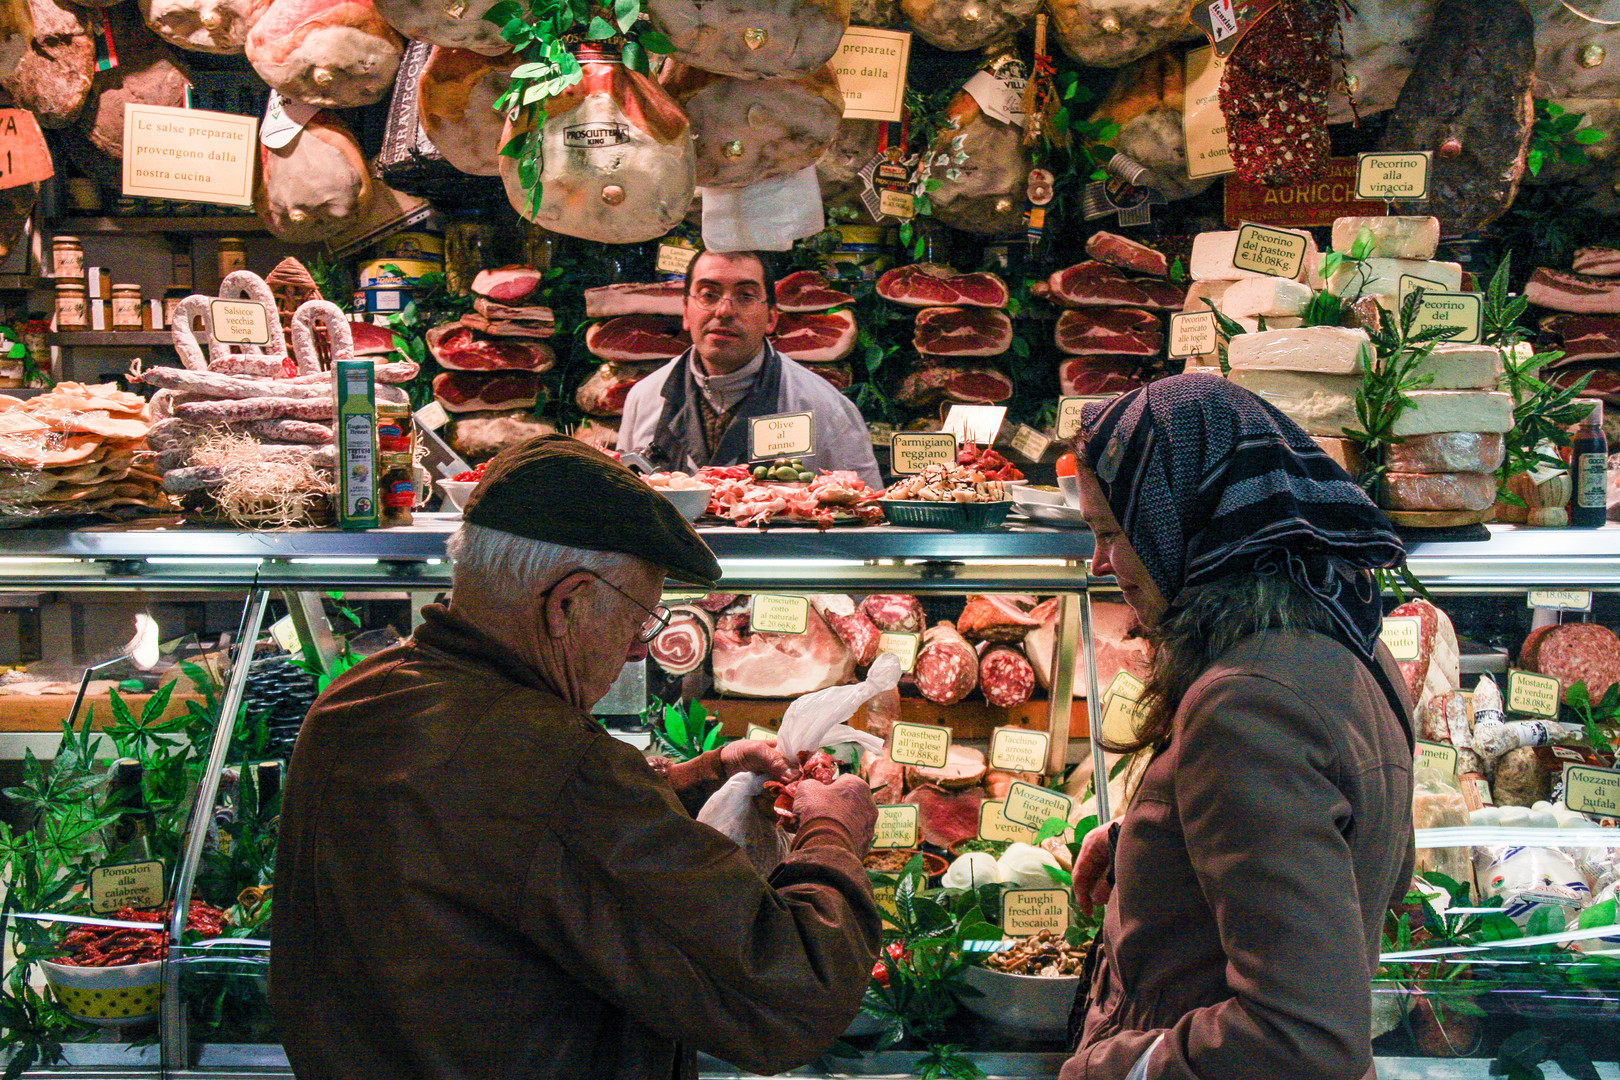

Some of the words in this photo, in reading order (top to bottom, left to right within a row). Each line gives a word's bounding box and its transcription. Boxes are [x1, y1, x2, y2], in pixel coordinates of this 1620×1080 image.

[1212, 3, 1235, 31] Renzini
[842, 44, 896, 56] preparate
[860, 67, 888, 78] dalla
[138, 119, 152, 130] Le
[156, 122, 184, 133] salse
[188, 127, 244, 140] preparate
[136, 145, 204, 159] provengono
[208, 150, 236, 162] dalla
[1370, 159, 1418, 169] Pecorino
[136, 169, 170, 179] nostra
[174, 171, 211, 183] cucina
[1382, 170, 1402, 180] alla
[1370, 183, 1414, 193] vinaccia
[1251, 231, 1293, 247] Pecorino
[1243, 241, 1258, 251] del
[1260, 245, 1296, 260] pastore
[1241, 252, 1292, 270] €.18.08Kg.
[224, 306, 254, 316] Salsicce
[1424, 301, 1465, 310] ecorino
[1181, 315, 1208, 324] Pecorino
[1431, 311, 1449, 320] del
[225, 317, 255, 326] vecchia
[230, 325, 252, 335] Siena
[1178, 335, 1190, 343] alle
[1190, 333, 1208, 343] foglie
[768, 421, 794, 431] Olive
[776, 431, 786, 439] al
[767, 441, 795, 451] ranno
[894, 438, 953, 449] Parmigiano
[901, 450, 948, 460] reggiano
[763, 596, 800, 605] Prosciutto
[769, 613, 799, 621] naturale
[1402, 627, 1412, 635] di
[1517, 676, 1553, 690] Mostarda
[1514, 687, 1523, 695] di
[1525, 689, 1554, 700] verdura
[900, 728, 942, 741] Roastbeef
[898, 739, 941, 752] all'inglese
[1003, 735, 1038, 746] Tacchino
[896, 748, 941, 763] €.19.88Kg.
[1005, 746, 1033, 754] arrosto
[1594, 786, 1605, 796] di
[1014, 786, 1065, 811] Mozzarella
[1583, 795, 1616, 809] bufala
[1022, 800, 1039, 813] fior
[1041, 805, 1051, 817] di
[883, 810, 902, 822] Sugo
[1023, 811, 1045, 824] latte
[881, 819, 914, 832] cinghiale
[995, 823, 1024, 833] verde
[102, 864, 151, 877] Pomodori
[118, 876, 136, 886] alla
[105, 887, 149, 898] calabrese
[1018, 893, 1053, 907] Funghi
[1009, 905, 1041, 916] freschi
[1045, 906, 1062, 915] alla
[1012, 918, 1059, 928] boscaiola
